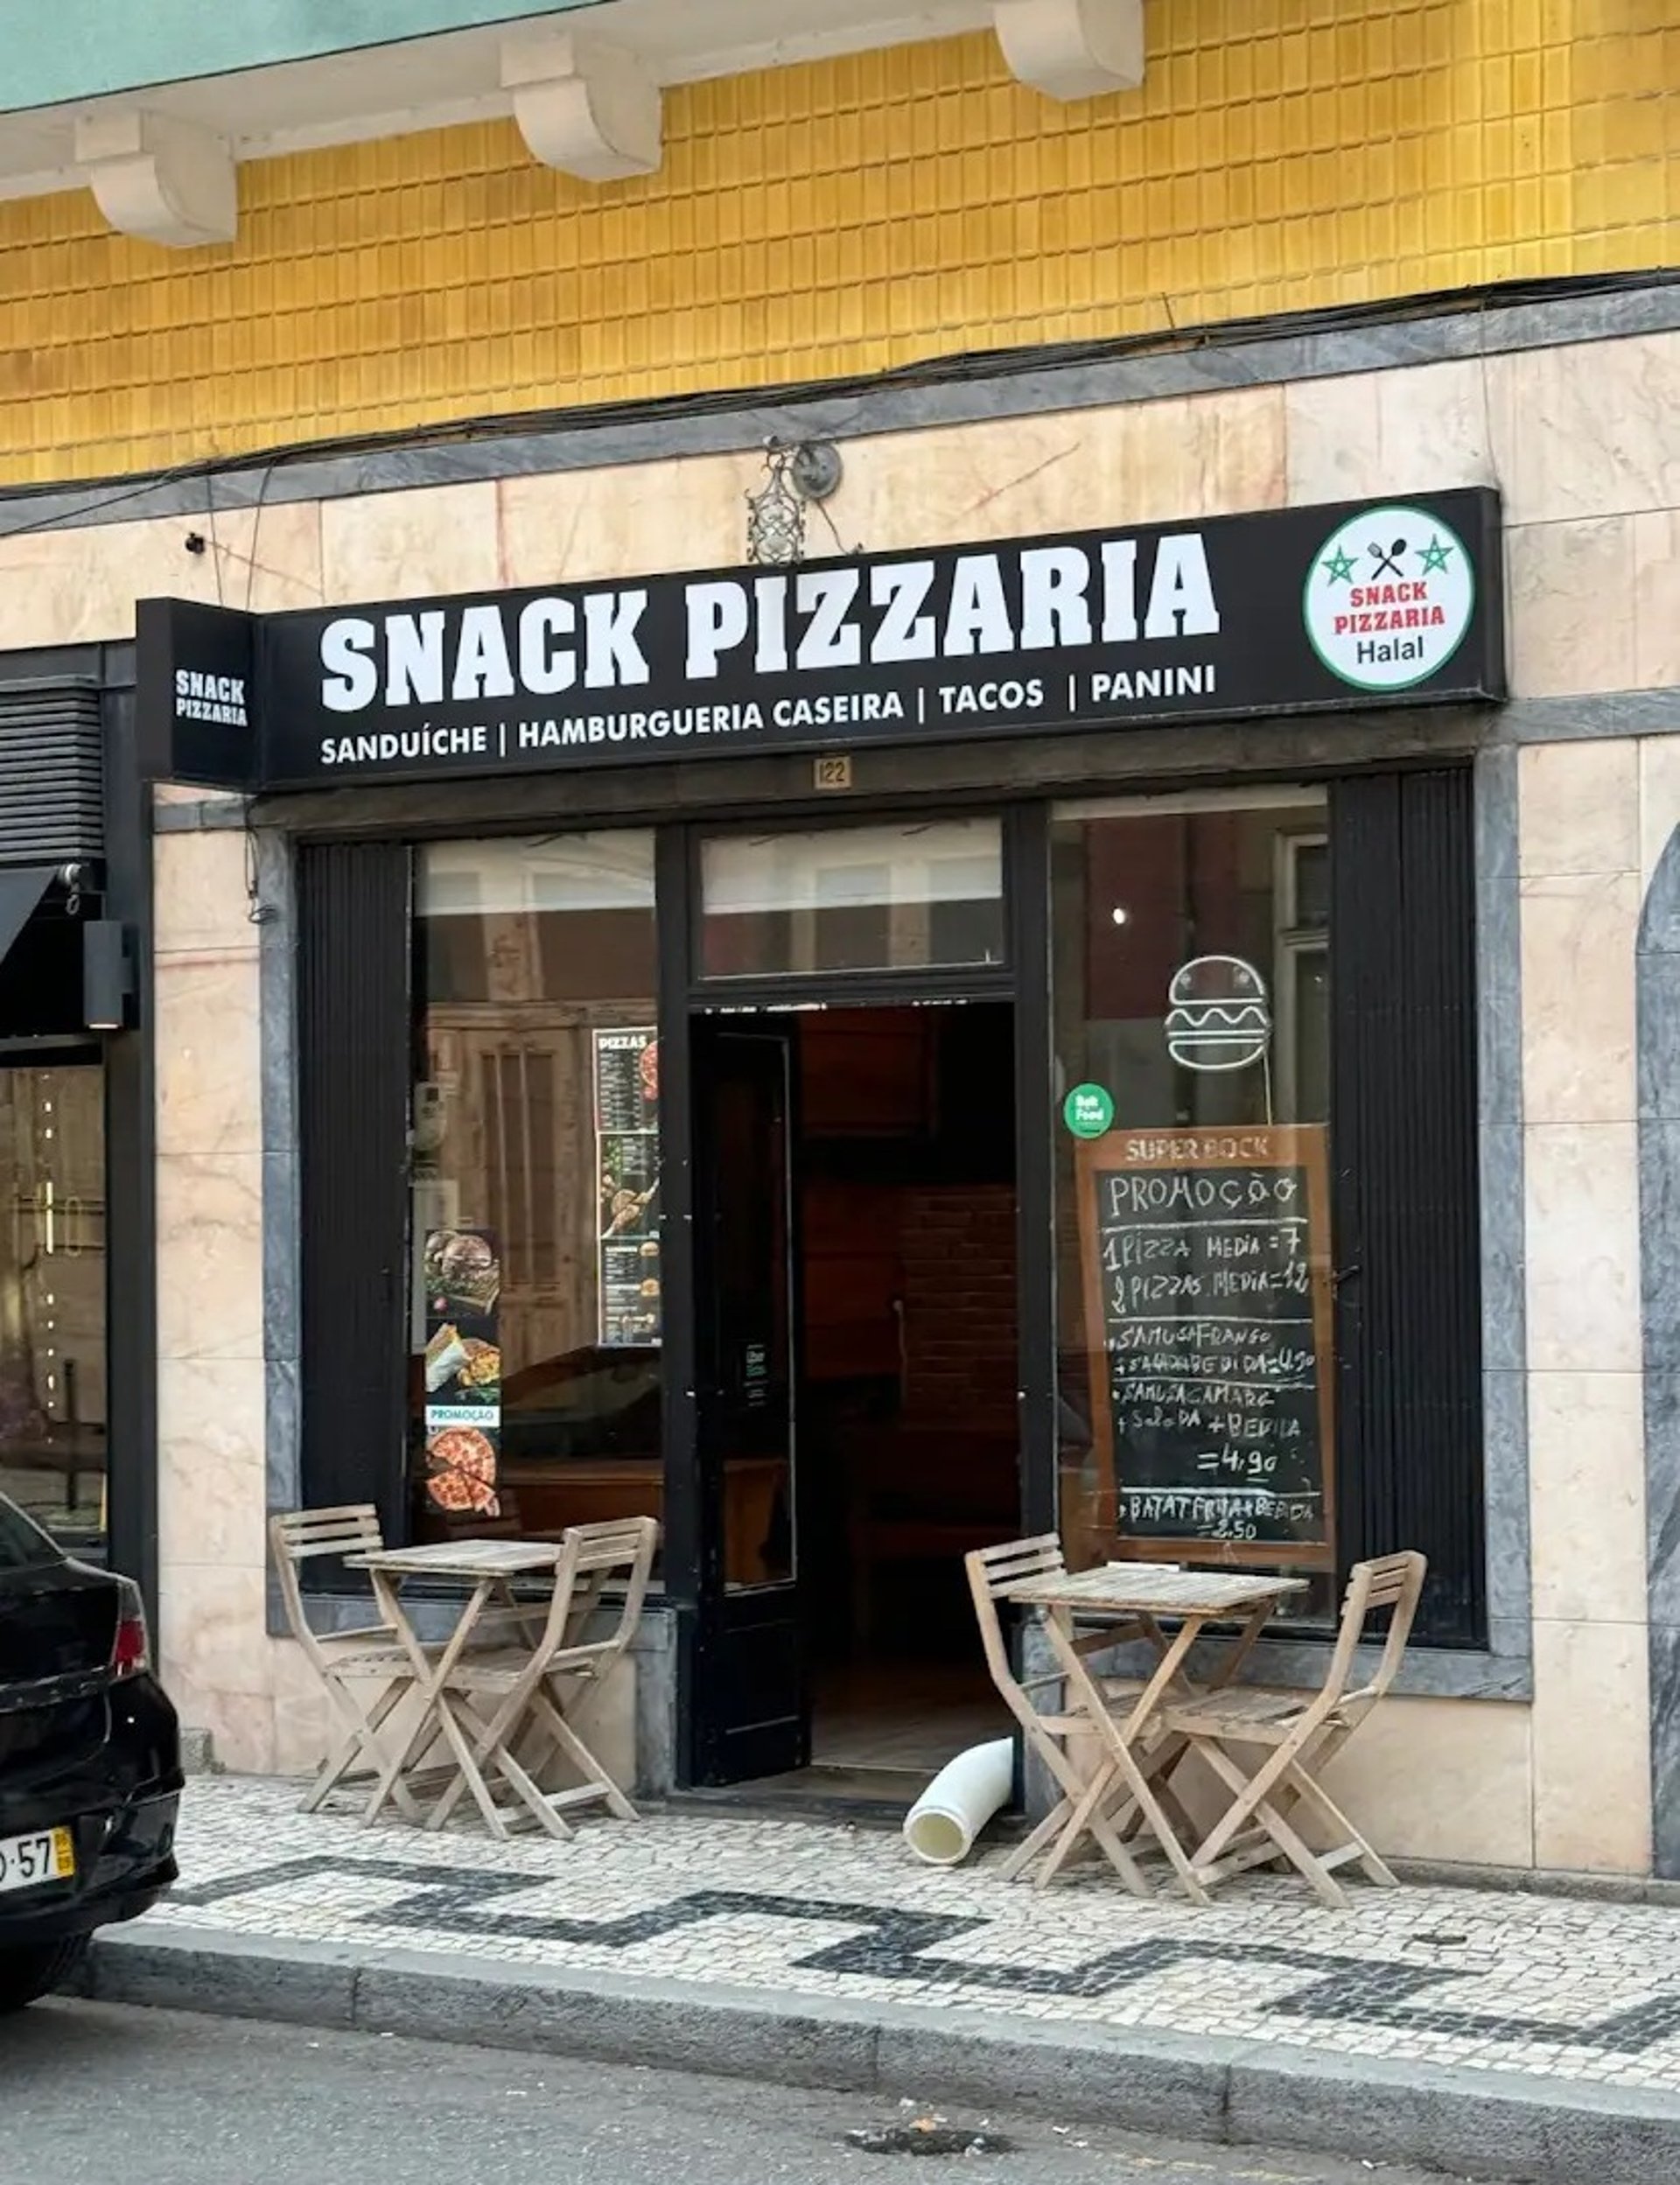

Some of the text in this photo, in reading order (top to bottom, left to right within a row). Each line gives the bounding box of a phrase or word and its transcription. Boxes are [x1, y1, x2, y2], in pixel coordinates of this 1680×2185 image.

[1349, 581, 1428, 608] SNACK
[321, 532, 1221, 712] SNACK PIZZARIA
[1334, 606, 1446, 635] PIZZARIA
[1356, 635, 1424, 664] Halal
[176, 669, 245, 705] SNACK
[176, 697, 248, 728] PIZZARIA
[320, 722, 488, 766] SANDUÍCHE
[519, 700, 764, 751] HAMBURGUERIA
[773, 692, 905, 729] CASEIRA
[939, 678, 1045, 714] TACOS
[1091, 664, 1216, 702] PANINI
[818, 760, 846, 784] 122
[598, 1036, 647, 1051] PIZZAS
